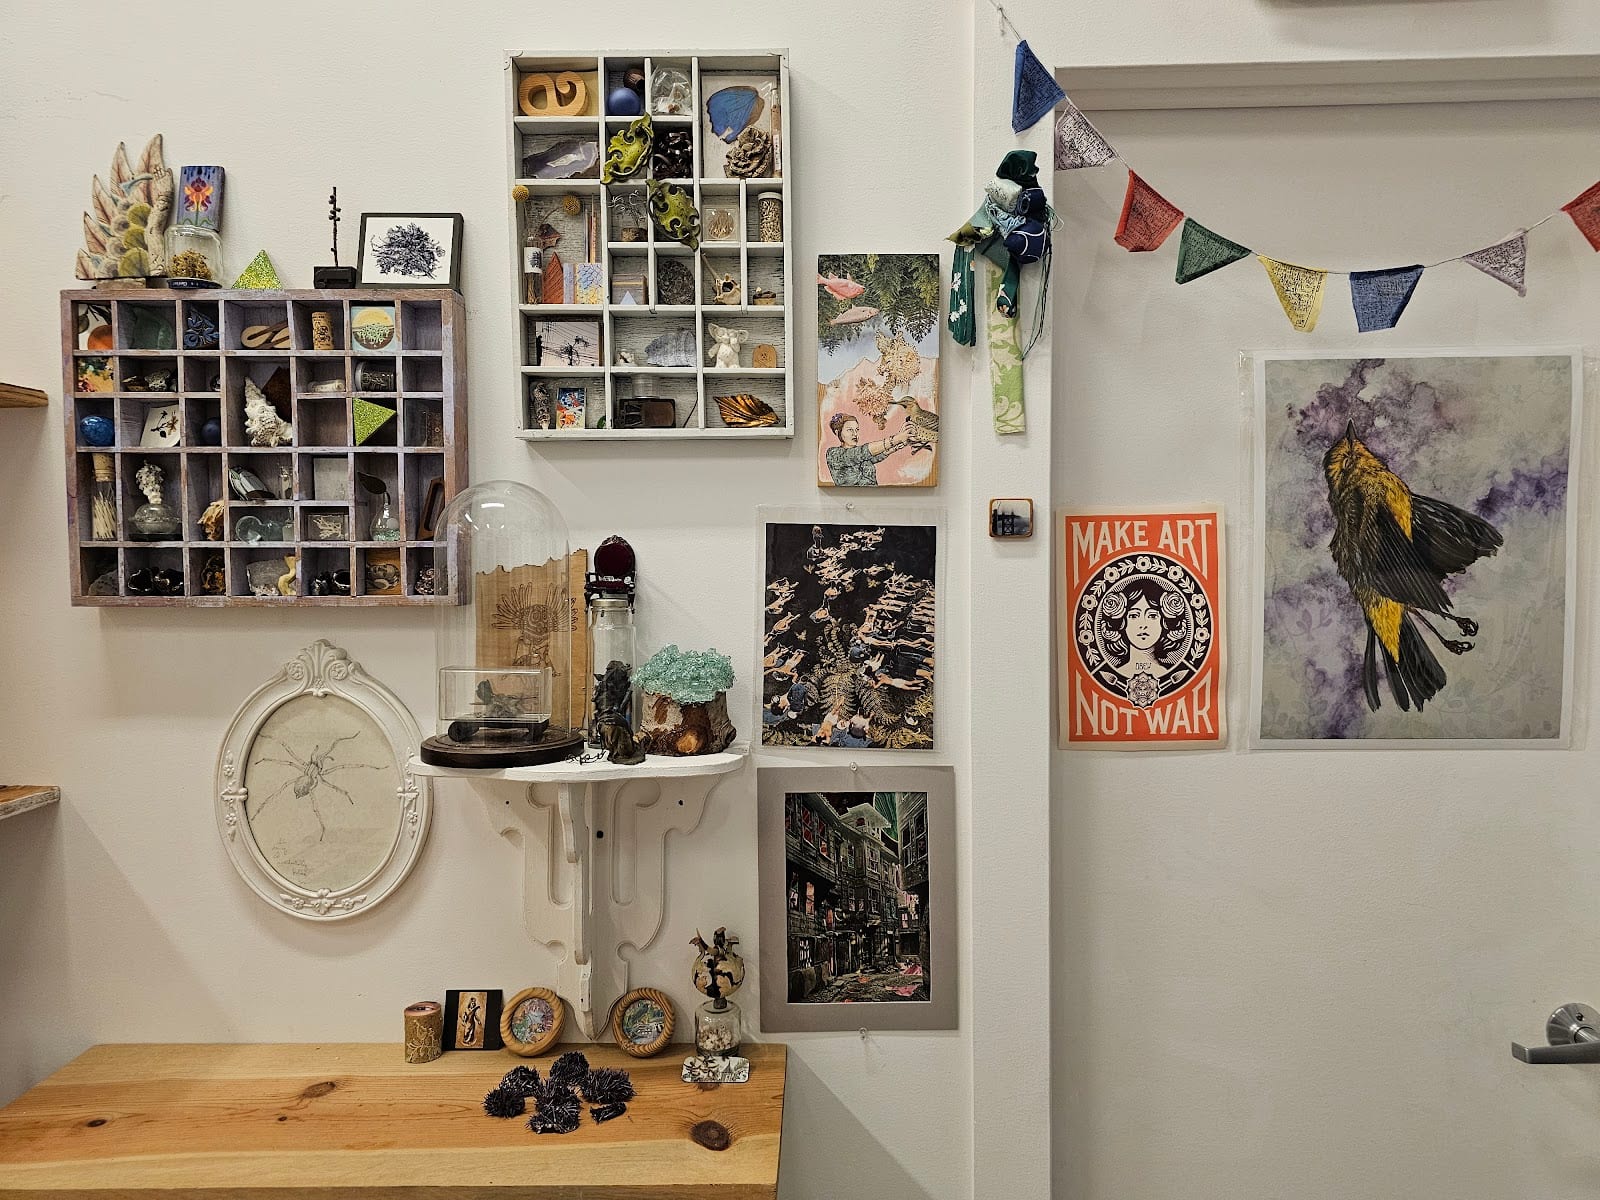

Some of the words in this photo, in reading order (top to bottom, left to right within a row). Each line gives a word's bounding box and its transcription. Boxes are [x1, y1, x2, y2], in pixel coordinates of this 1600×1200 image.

[1071, 520, 1149, 590] MAKE
[1158, 519, 1212, 581] ART
[1075, 669, 1140, 736] NOT
[1145, 667, 1214, 735] WAR
